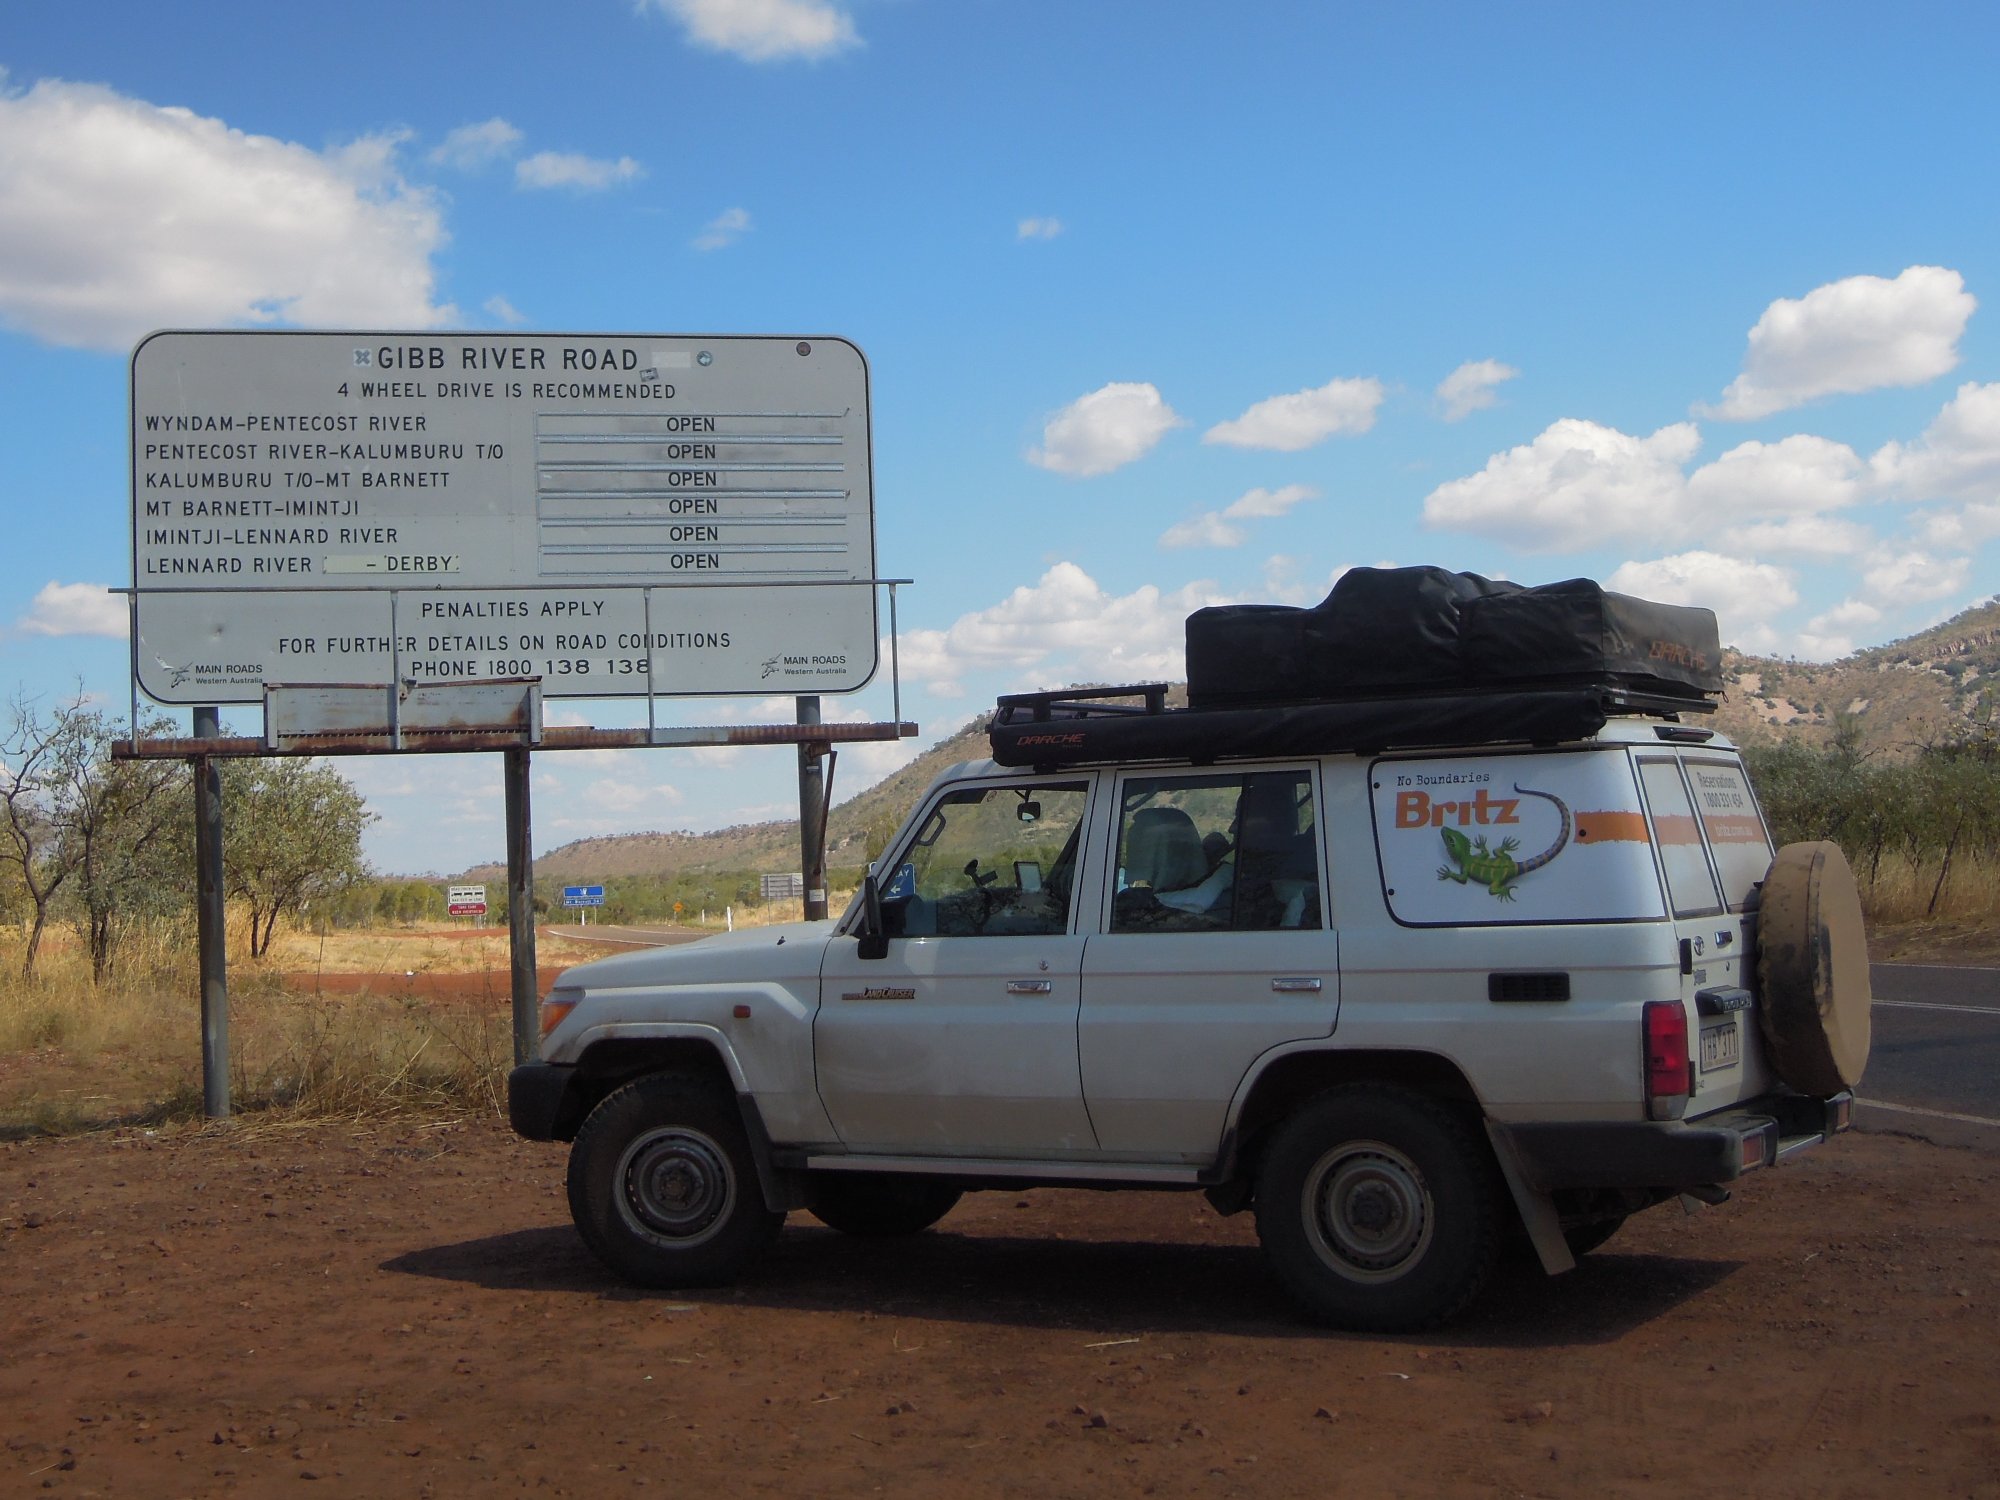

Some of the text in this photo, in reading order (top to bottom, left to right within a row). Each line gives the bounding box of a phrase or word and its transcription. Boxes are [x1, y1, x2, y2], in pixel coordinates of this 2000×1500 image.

[379, 347, 637, 370] GIBB RIVER ROAD
[338, 383, 675, 398] 4 WHEEL DRIVE IS RECOMMENDED
[146, 416, 425, 431] WYNDAM-PENTECOST RIVER
[667, 415, 714, 431] OPEN
[147, 445, 503, 459] PENTECOST RIVER-KALUMBURU T/O
[668, 445, 715, 458] OPEN
[147, 473, 271, 488] KALUMBURU
[363, 473, 449, 487] BARNETT
[669, 472, 716, 486] OPEN
[147, 501, 357, 516] MT BARNETT-IMINTJI
[669, 499, 717, 513] OPEN
[147, 529, 397, 544] IMINTJI-LENNARD RIVER
[670, 527, 717, 541] OPEN
[148, 558, 241, 573] LENNARD
[254, 558, 311, 572] RIVER
[387, 557, 450, 570] DERBY
[671, 554, 718, 568] OPEN
[423, 601, 603, 617] PENALTIES APPLY
[280, 633, 731, 653] FOR FURTHER DETAILS ON ROAD CONDITIONS
[413, 659, 649, 676] PHONE 1800 138 138
[813, 656, 845, 664] ROADS
[196, 665, 262, 673] MAIN ROADS
[1017, 734, 1086, 745] DARCHE
[1397, 772, 1490, 786] No Boundaries
[1395, 789, 1520, 829] Britz
